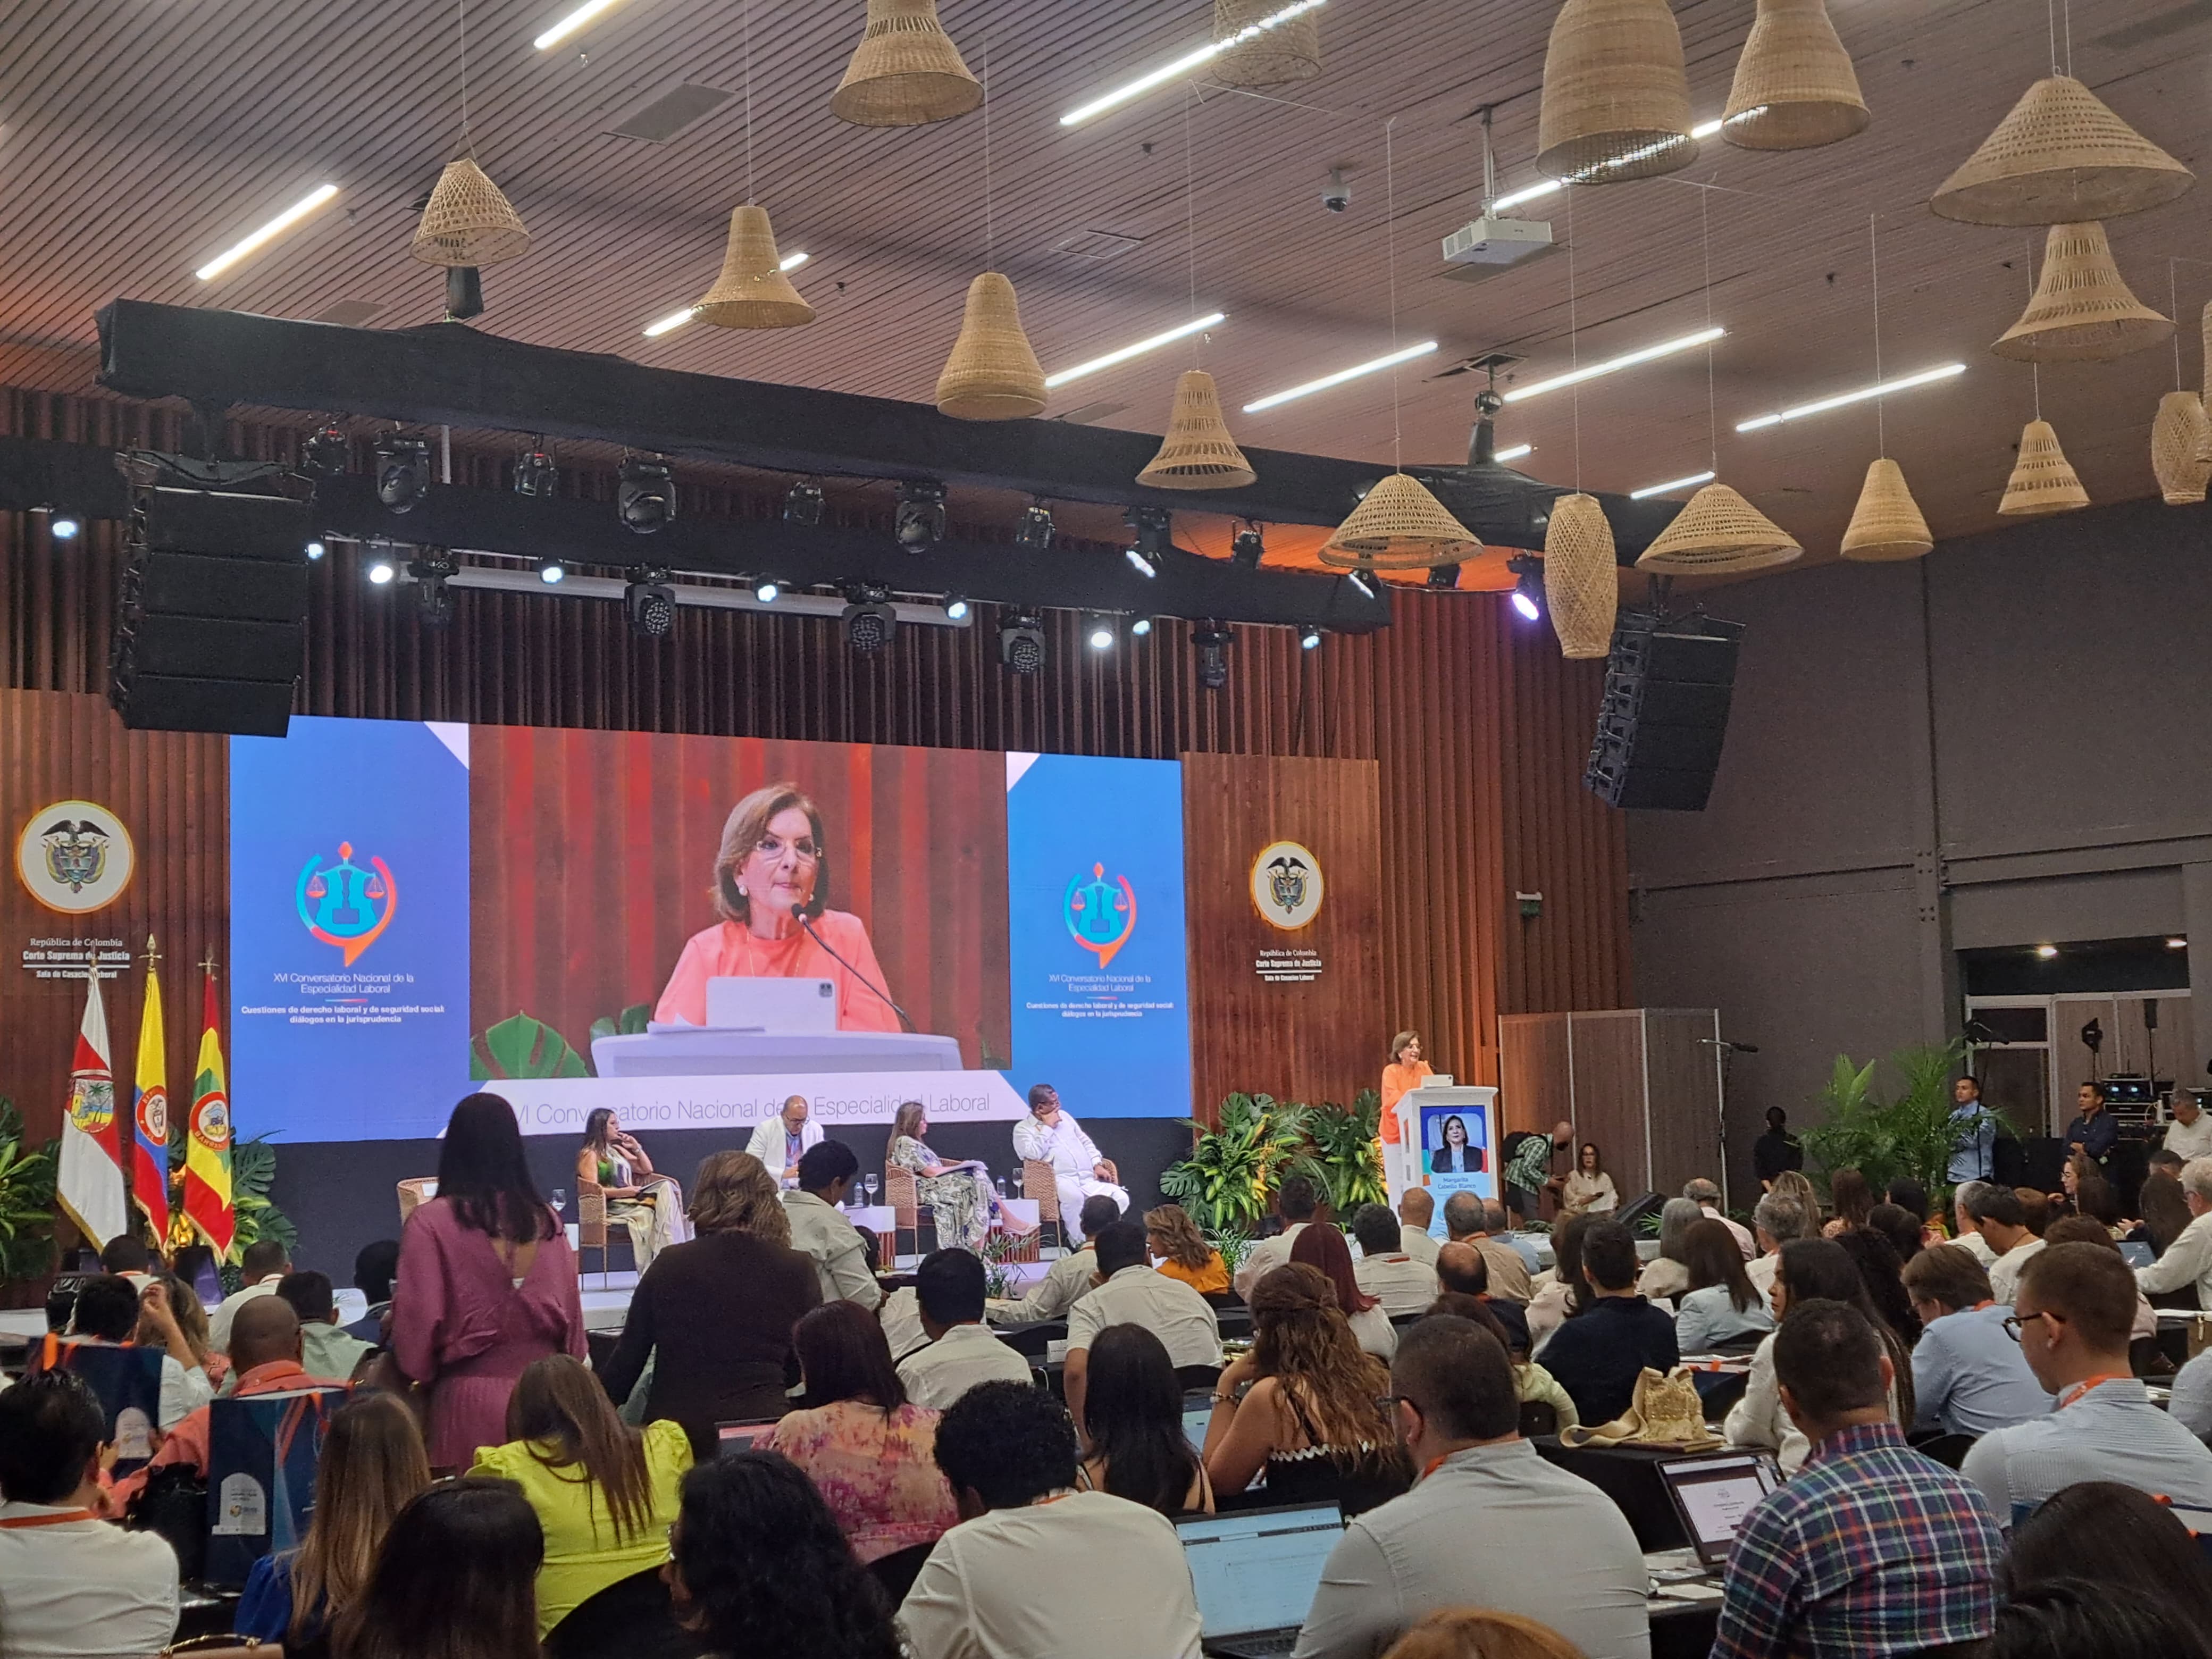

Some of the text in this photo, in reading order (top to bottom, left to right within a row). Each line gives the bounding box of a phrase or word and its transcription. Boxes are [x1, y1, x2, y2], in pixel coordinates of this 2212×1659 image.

[30, 938, 70, 948] República
[72, 937, 82, 946] de
[23, 951, 45, 961] Corte
[47, 951, 83, 961] Suprema
[98, 950, 130, 961] Justicia
[53, 970, 61, 978] de
[273, 973, 414, 983] XVI Conversatorio Nacional de la
[1049, 974, 1060, 983] XVI
[1060, 974, 1105, 983] Conversatorio
[1106, 974, 1134, 983] Nacional
[1135, 974, 1144, 983] de
[300, 984, 391, 995] Especialidad Laboral
[1068, 984, 1109, 993] Especialidad
[380, 1006, 418, 1014] seguridad
[290, 1016, 324, 1025] diálogos
[346, 1015, 401, 1024] jurisprudencia
[537, 1101, 671, 1125] Convsatorio
[678, 1099, 757, 1119] Nacional
[814, 1094, 923, 1119] Especialidd
[929, 1093, 990, 1112] Laboral
